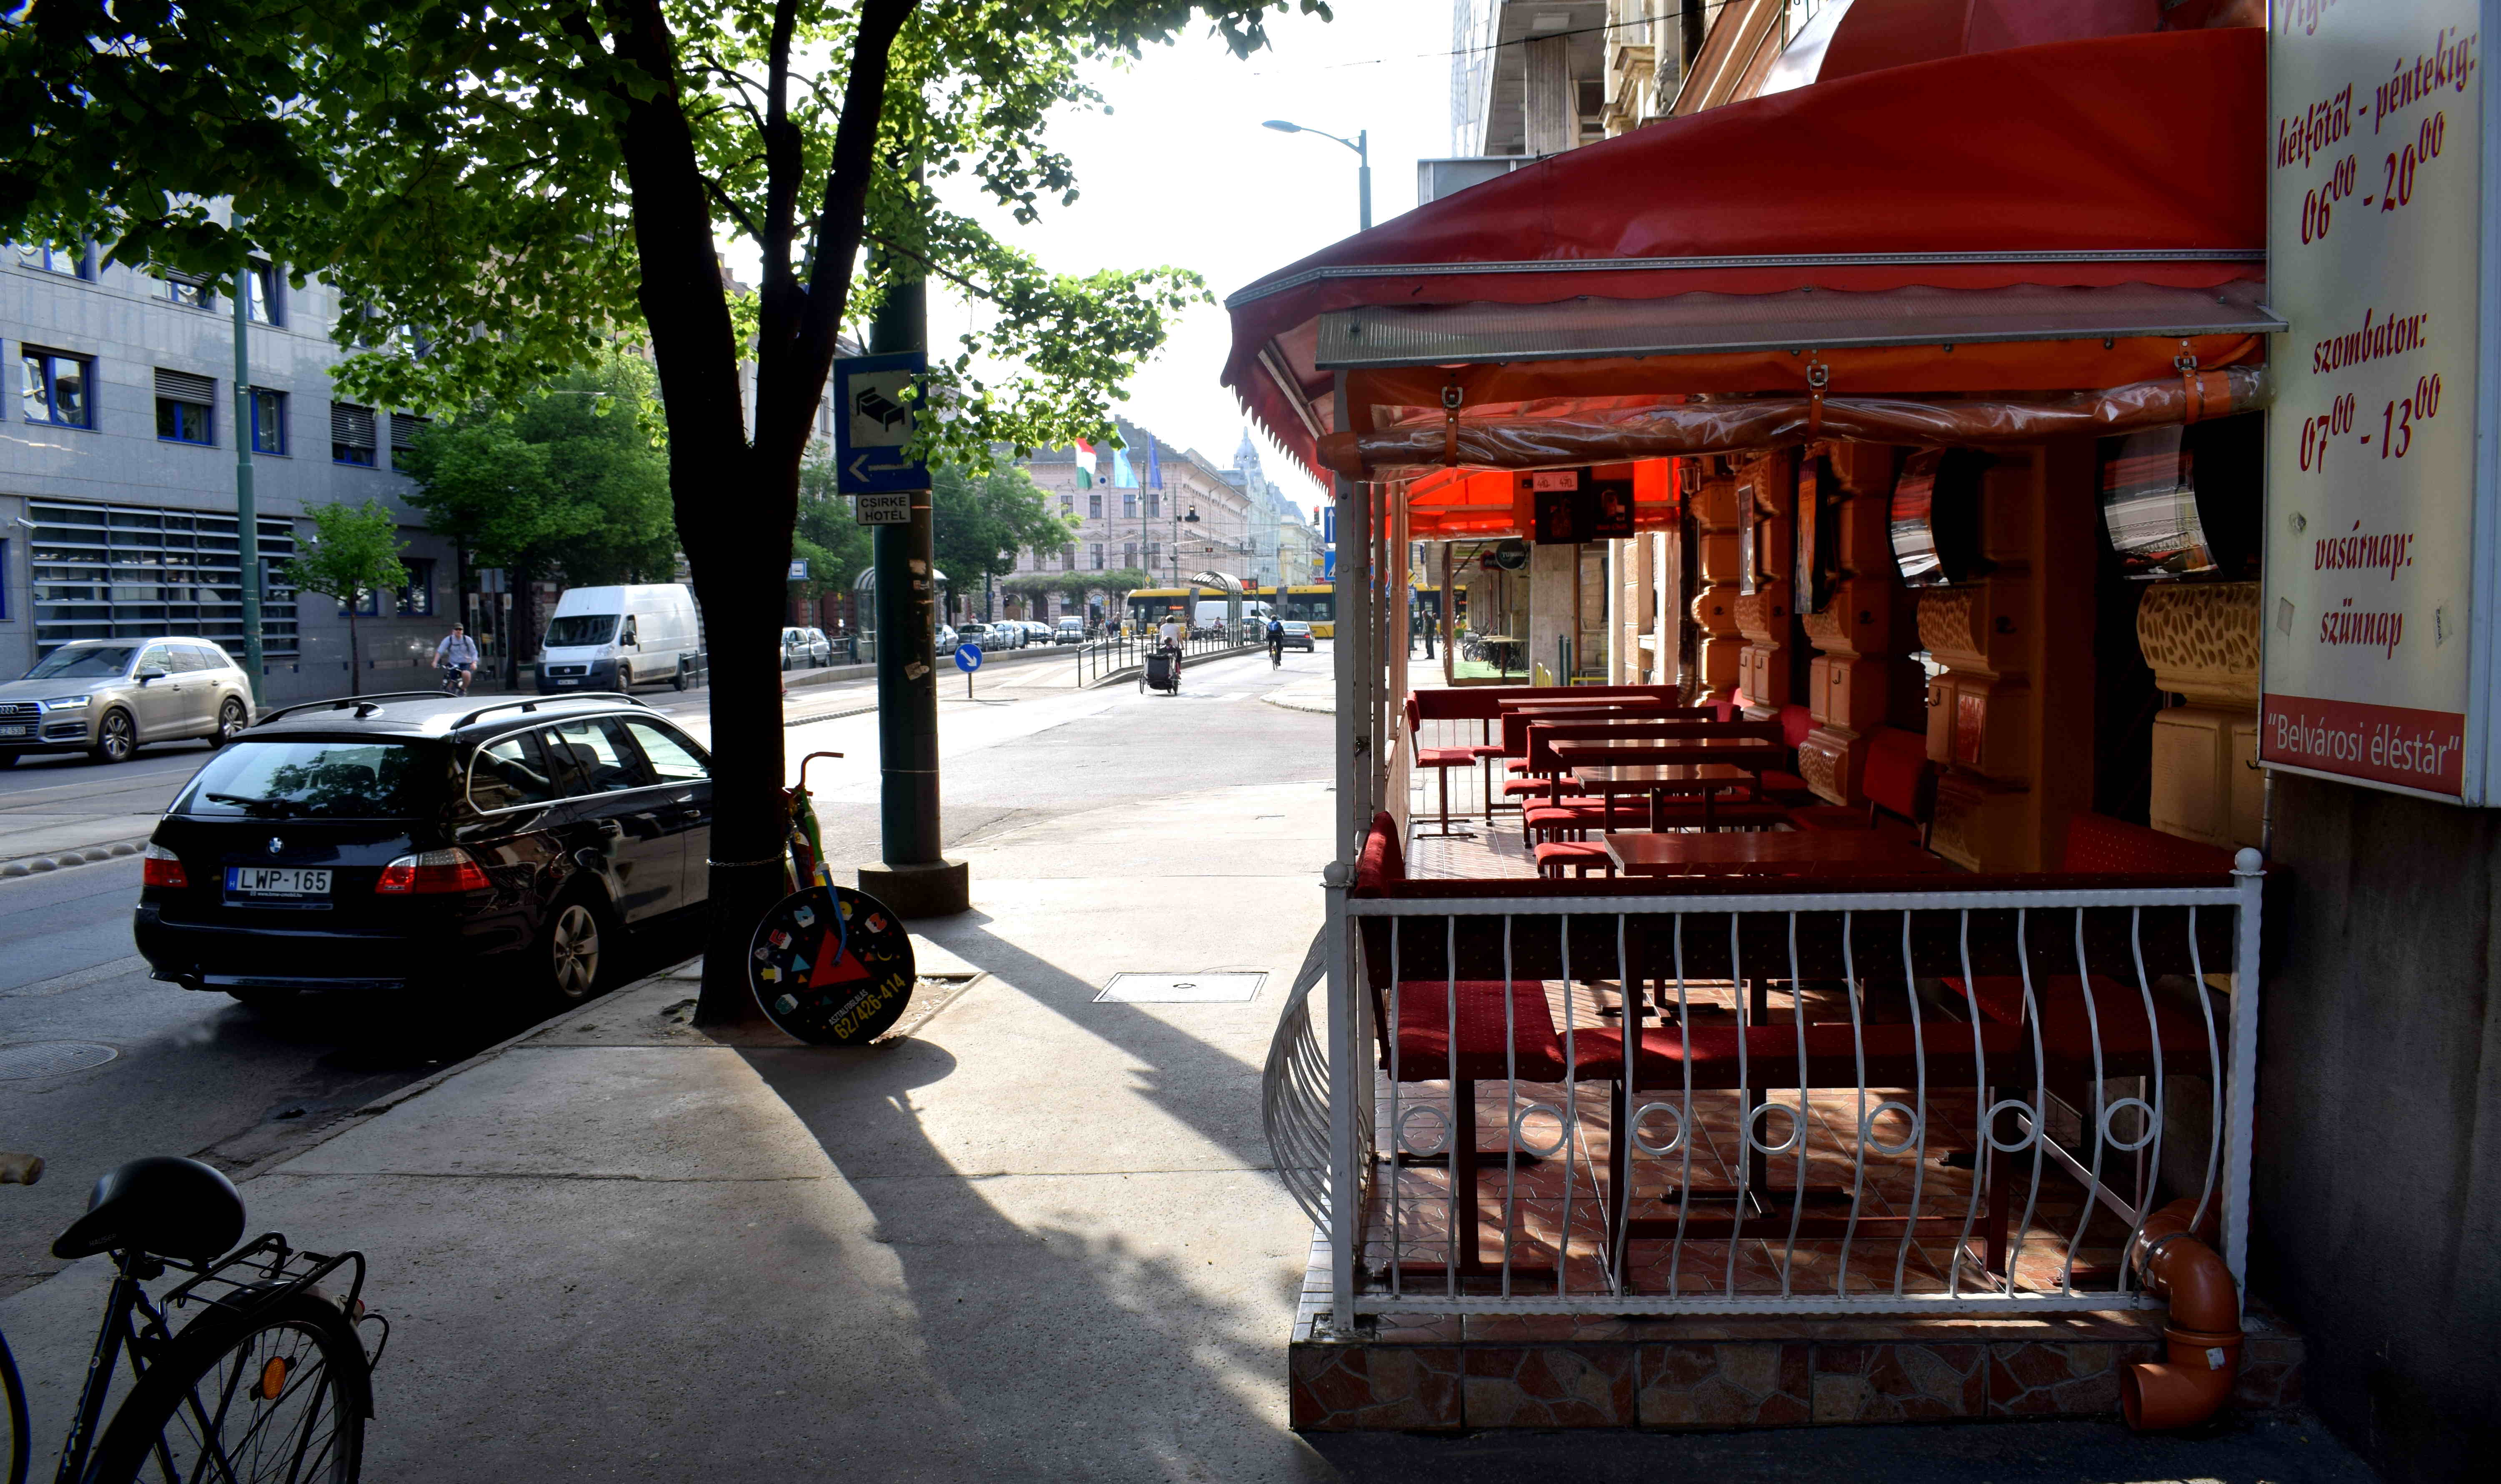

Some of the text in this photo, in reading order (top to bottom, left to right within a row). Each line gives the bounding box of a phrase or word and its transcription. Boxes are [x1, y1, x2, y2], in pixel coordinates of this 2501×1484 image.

[2277, 82, 2352, 169] hétfőtől
[2375, 25, 2477, 135] péntekig:
[2313, 308, 2427, 375] szombaton:
[861, 496, 906, 508] CSIRKE
[865, 510, 906, 521] HOTEL
[2314, 520, 2413, 581] vasárnap:
[2320, 597, 2403, 660] szünnap
[241, 870, 326, 891] LWP-165
[834, 973, 906, 1039] 62/426-414
[89, 1233, 117, 1247] HAUSER
